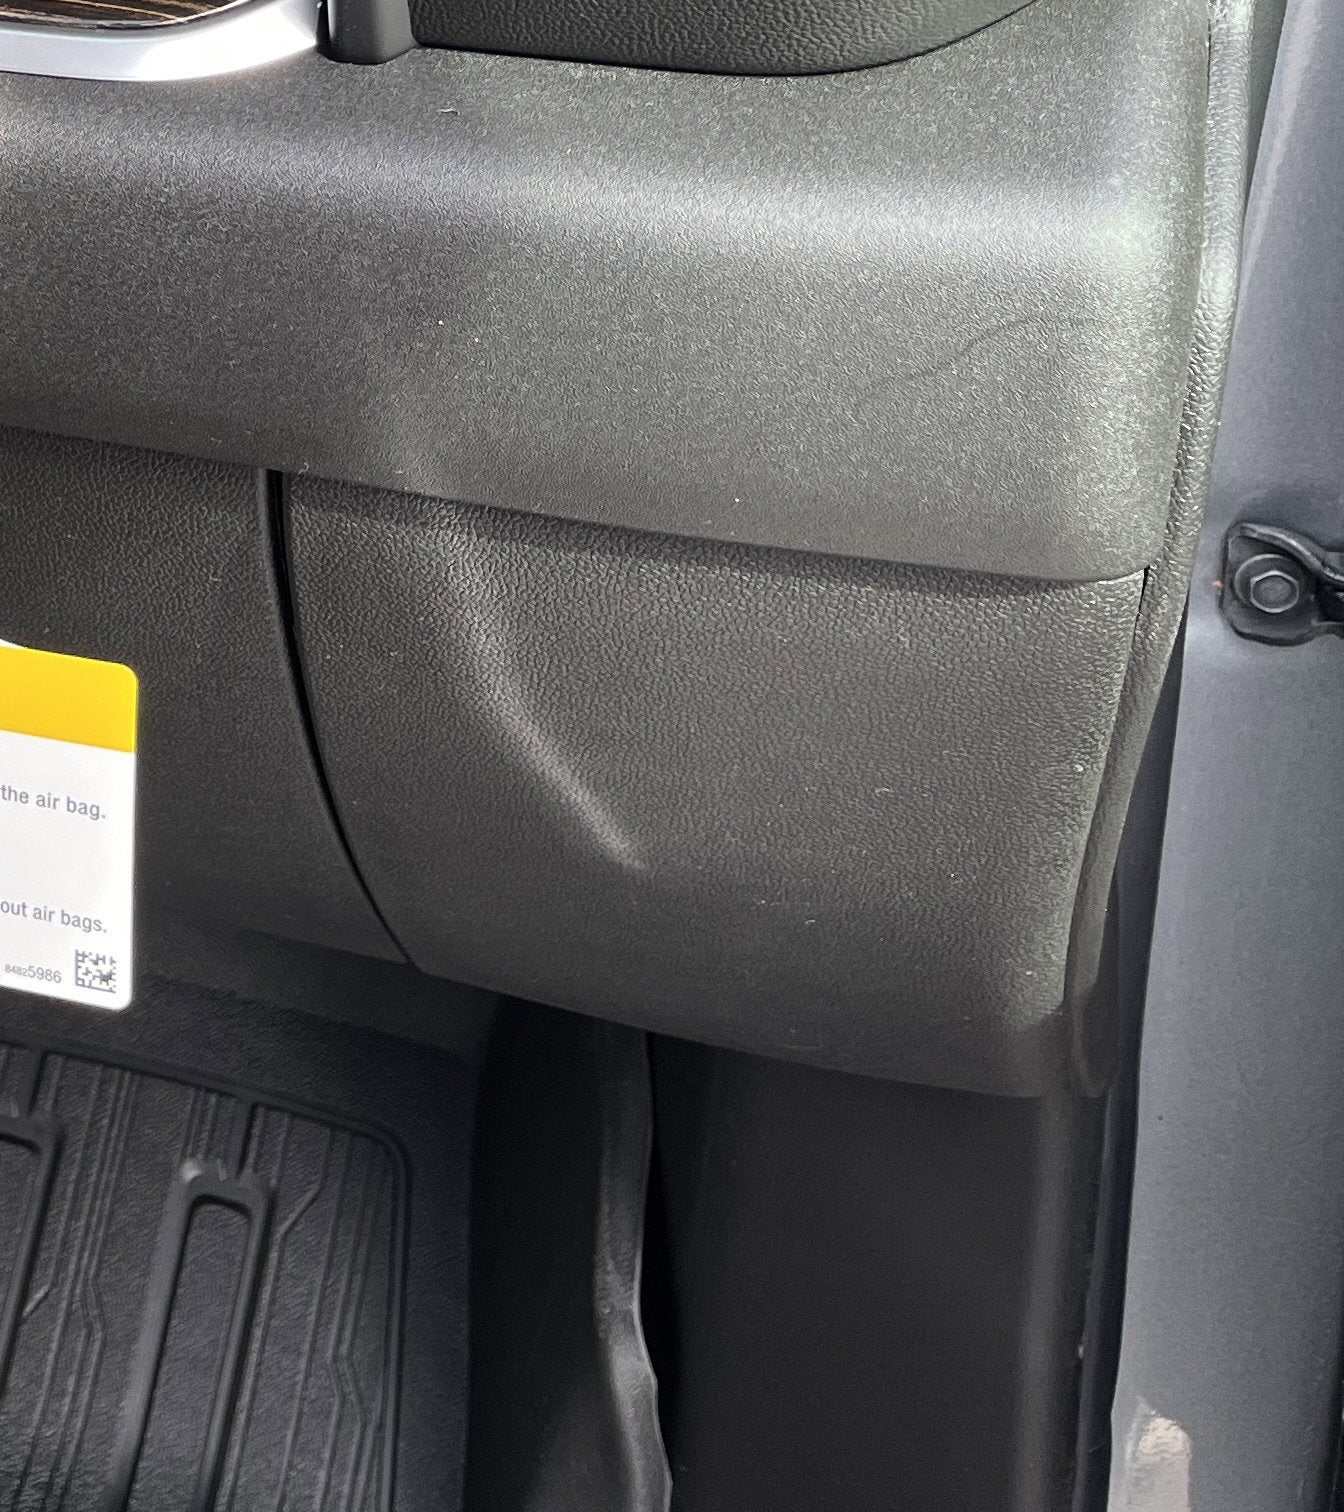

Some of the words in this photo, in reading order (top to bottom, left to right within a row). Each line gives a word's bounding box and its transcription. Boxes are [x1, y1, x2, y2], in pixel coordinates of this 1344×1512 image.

[0, 784, 29, 805] the
[35, 790, 60, 810] air
[66, 796, 106, 821] bag.
[32, 905, 56, 924] air
[60, 908, 108, 934] bags.
